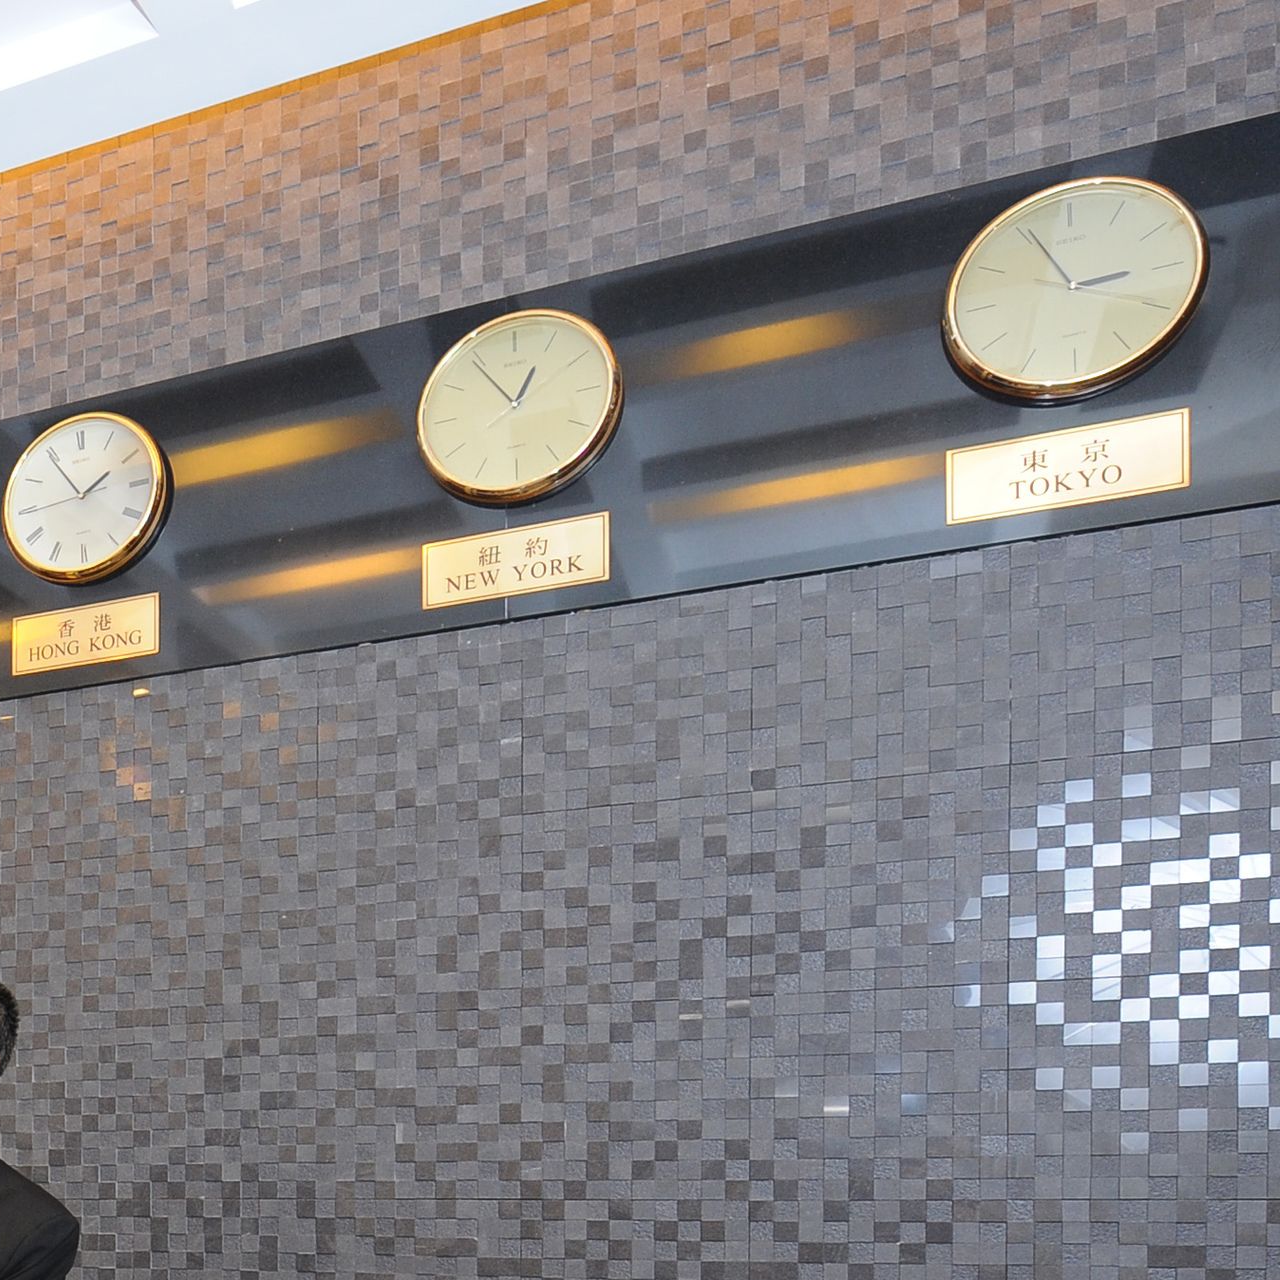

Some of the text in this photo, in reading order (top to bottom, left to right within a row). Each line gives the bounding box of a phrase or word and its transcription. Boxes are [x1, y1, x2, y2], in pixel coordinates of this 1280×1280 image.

[1020, 438, 1111, 474] 東京
[1009, 463, 1123, 500] TOKYO
[479, 537, 548, 567] 紐約
[446, 555, 584, 593] NEW YORK
[58, 613, 112, 639] 香港
[29, 630, 141, 662] HONG KONG
